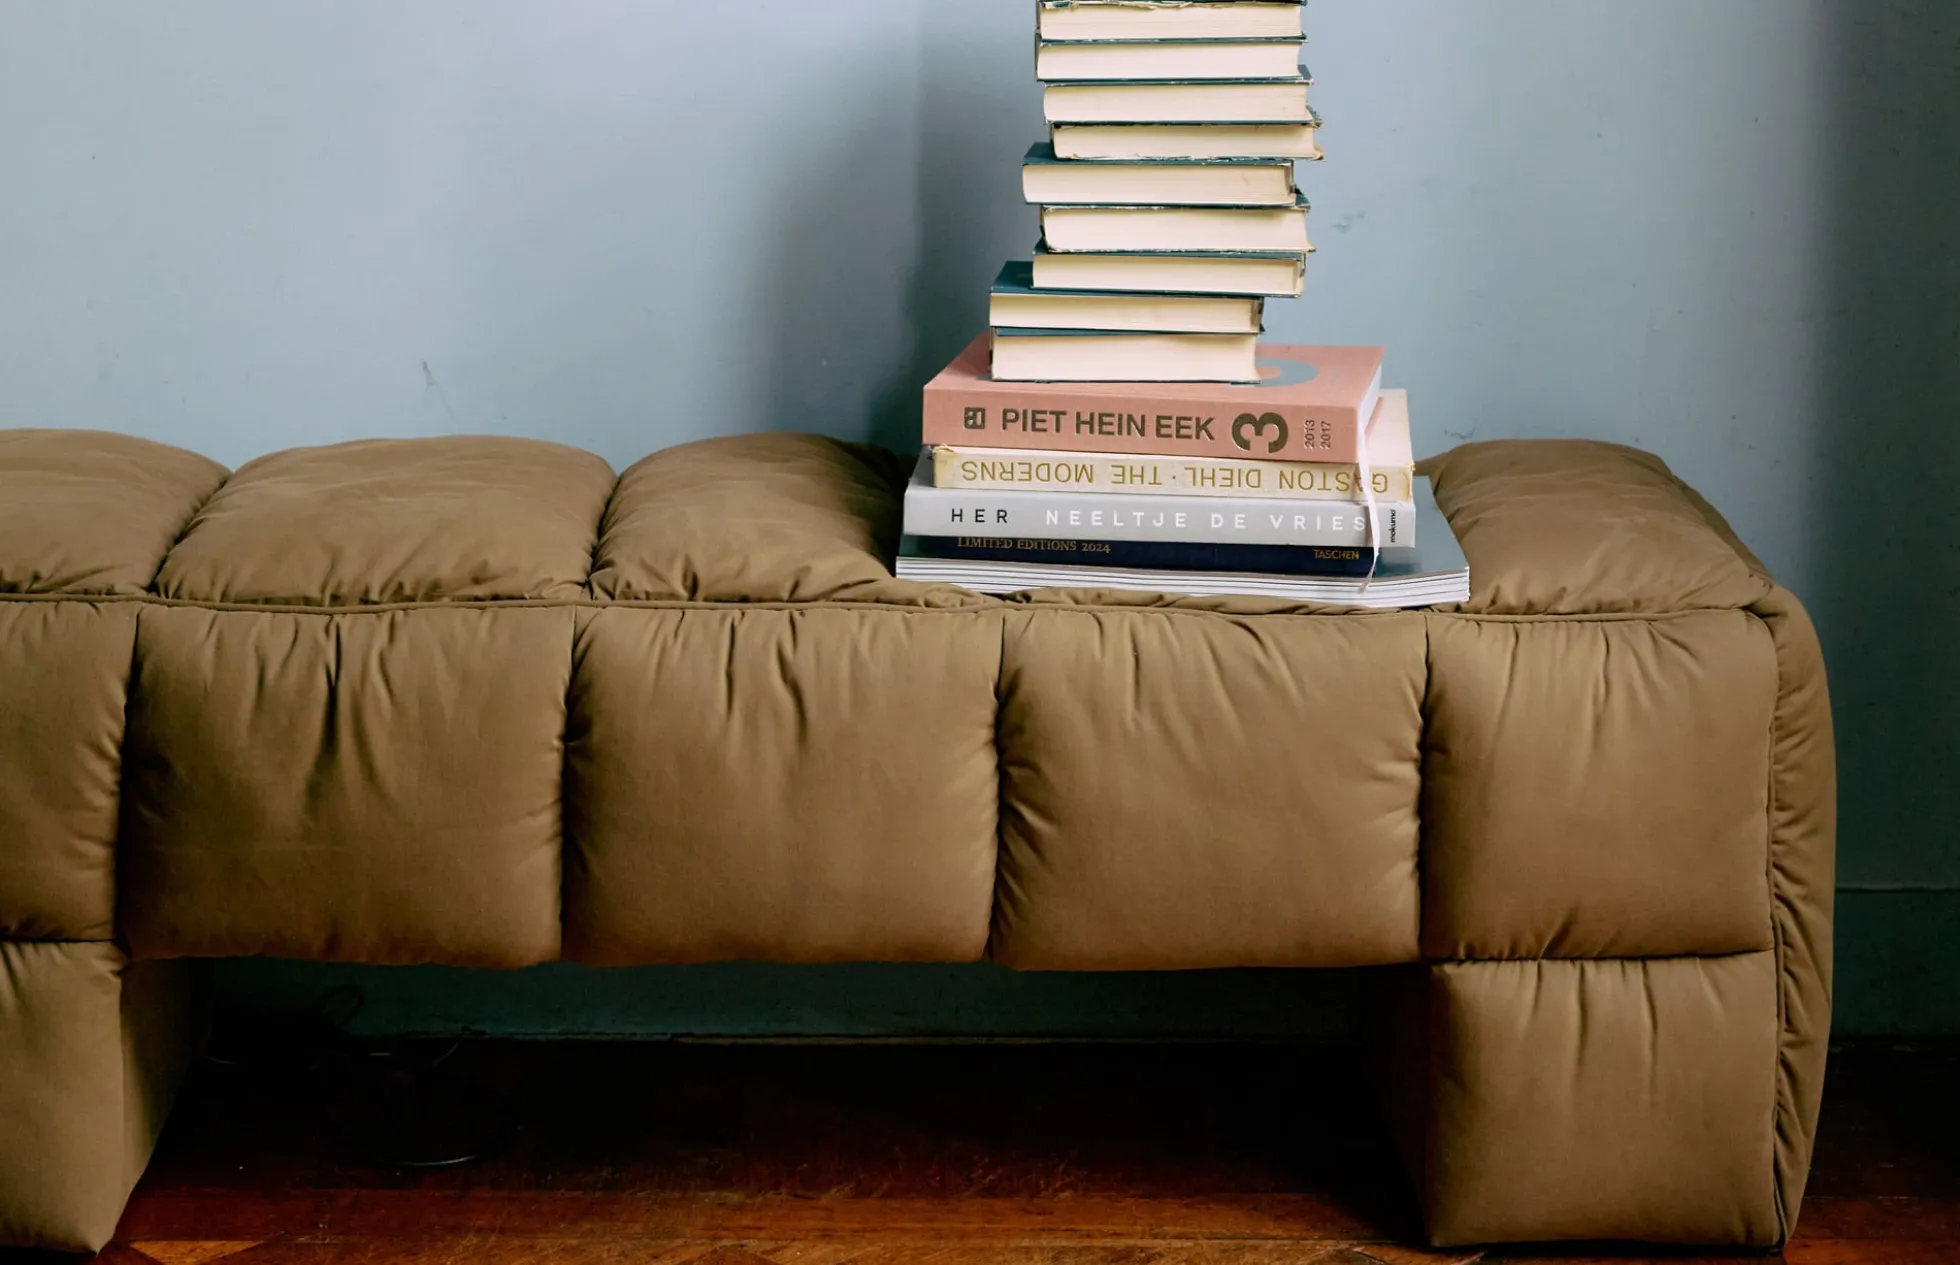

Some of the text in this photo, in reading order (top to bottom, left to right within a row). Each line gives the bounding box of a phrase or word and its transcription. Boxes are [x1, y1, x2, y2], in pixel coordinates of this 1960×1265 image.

[1002, 408, 1215, 441] PIET HEIN EEK
[1231, 412, 1289, 453] 3
[1304, 419, 1315, 449] 2013
[1320, 420, 1332, 449] 2017
[961, 461, 1094, 483] MODERNS
[1111, 465, 1162, 485] THE
[1184, 467, 1261, 488] DIEHL
[951, 508, 1365, 531] HER NEELTJE DE VRIES
[957, 536, 1112, 554] LIMITED EDITIONS 2024
[1313, 549, 1360, 560] TASCHEN
